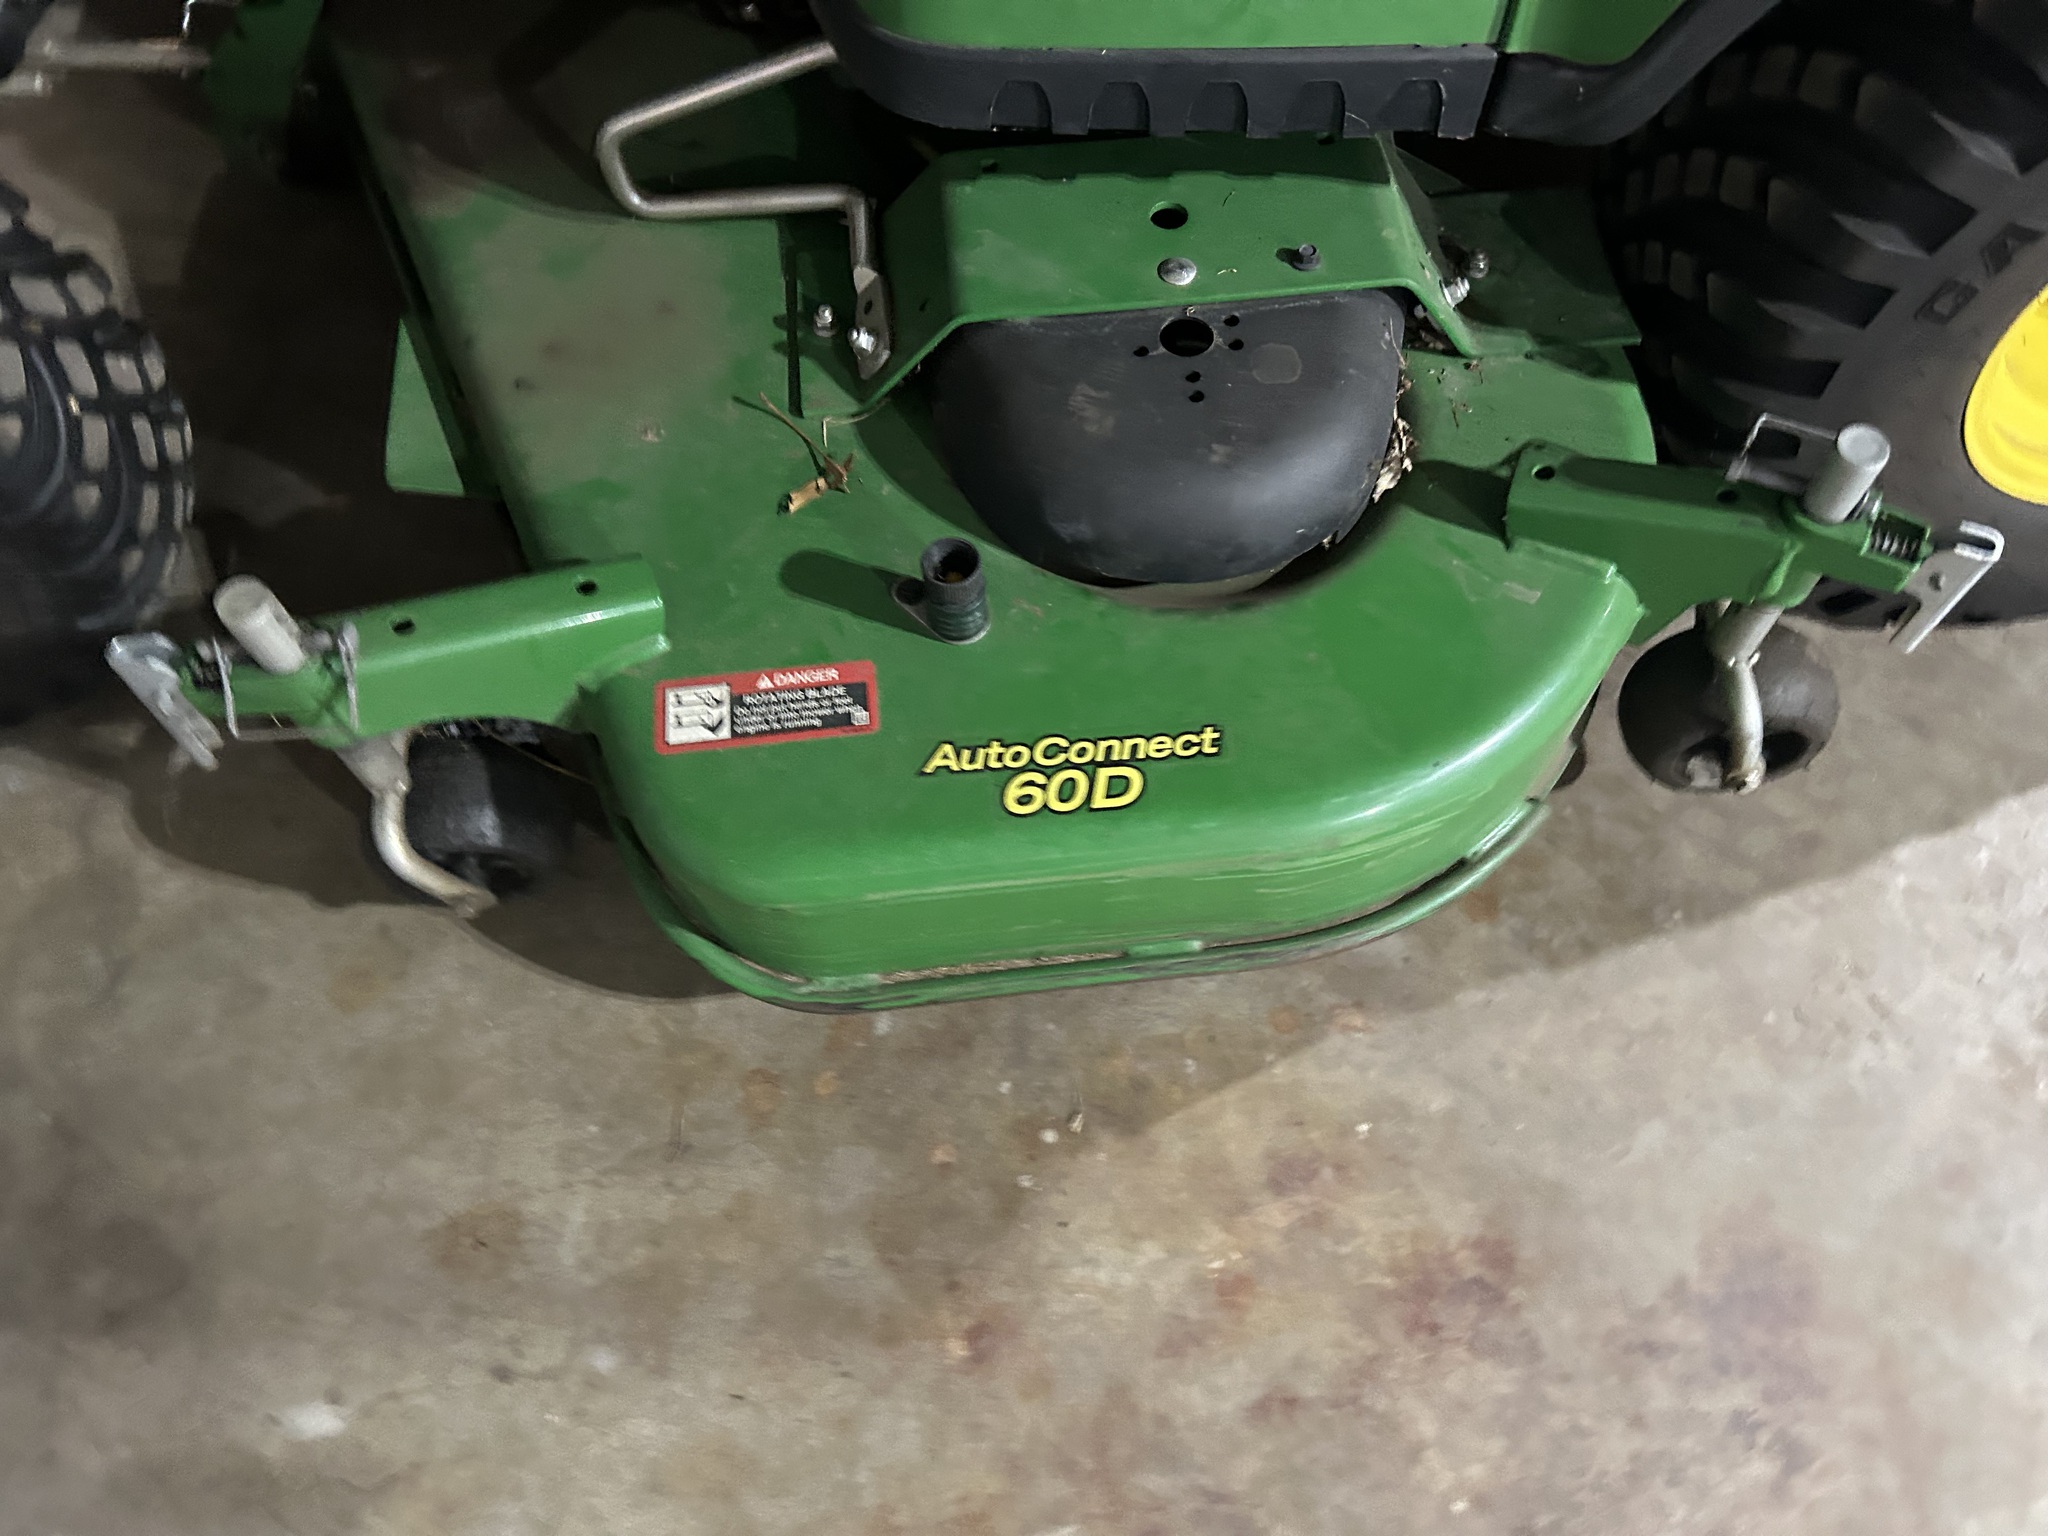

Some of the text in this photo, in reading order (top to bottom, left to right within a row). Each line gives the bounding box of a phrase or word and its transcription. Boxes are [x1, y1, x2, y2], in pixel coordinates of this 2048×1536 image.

[772, 667, 840, 687] DANGER
[804, 684, 847, 699] BLADE
[919, 725, 1222, 775] AutoConnect
[1001, 765, 1146, 816] 60D
